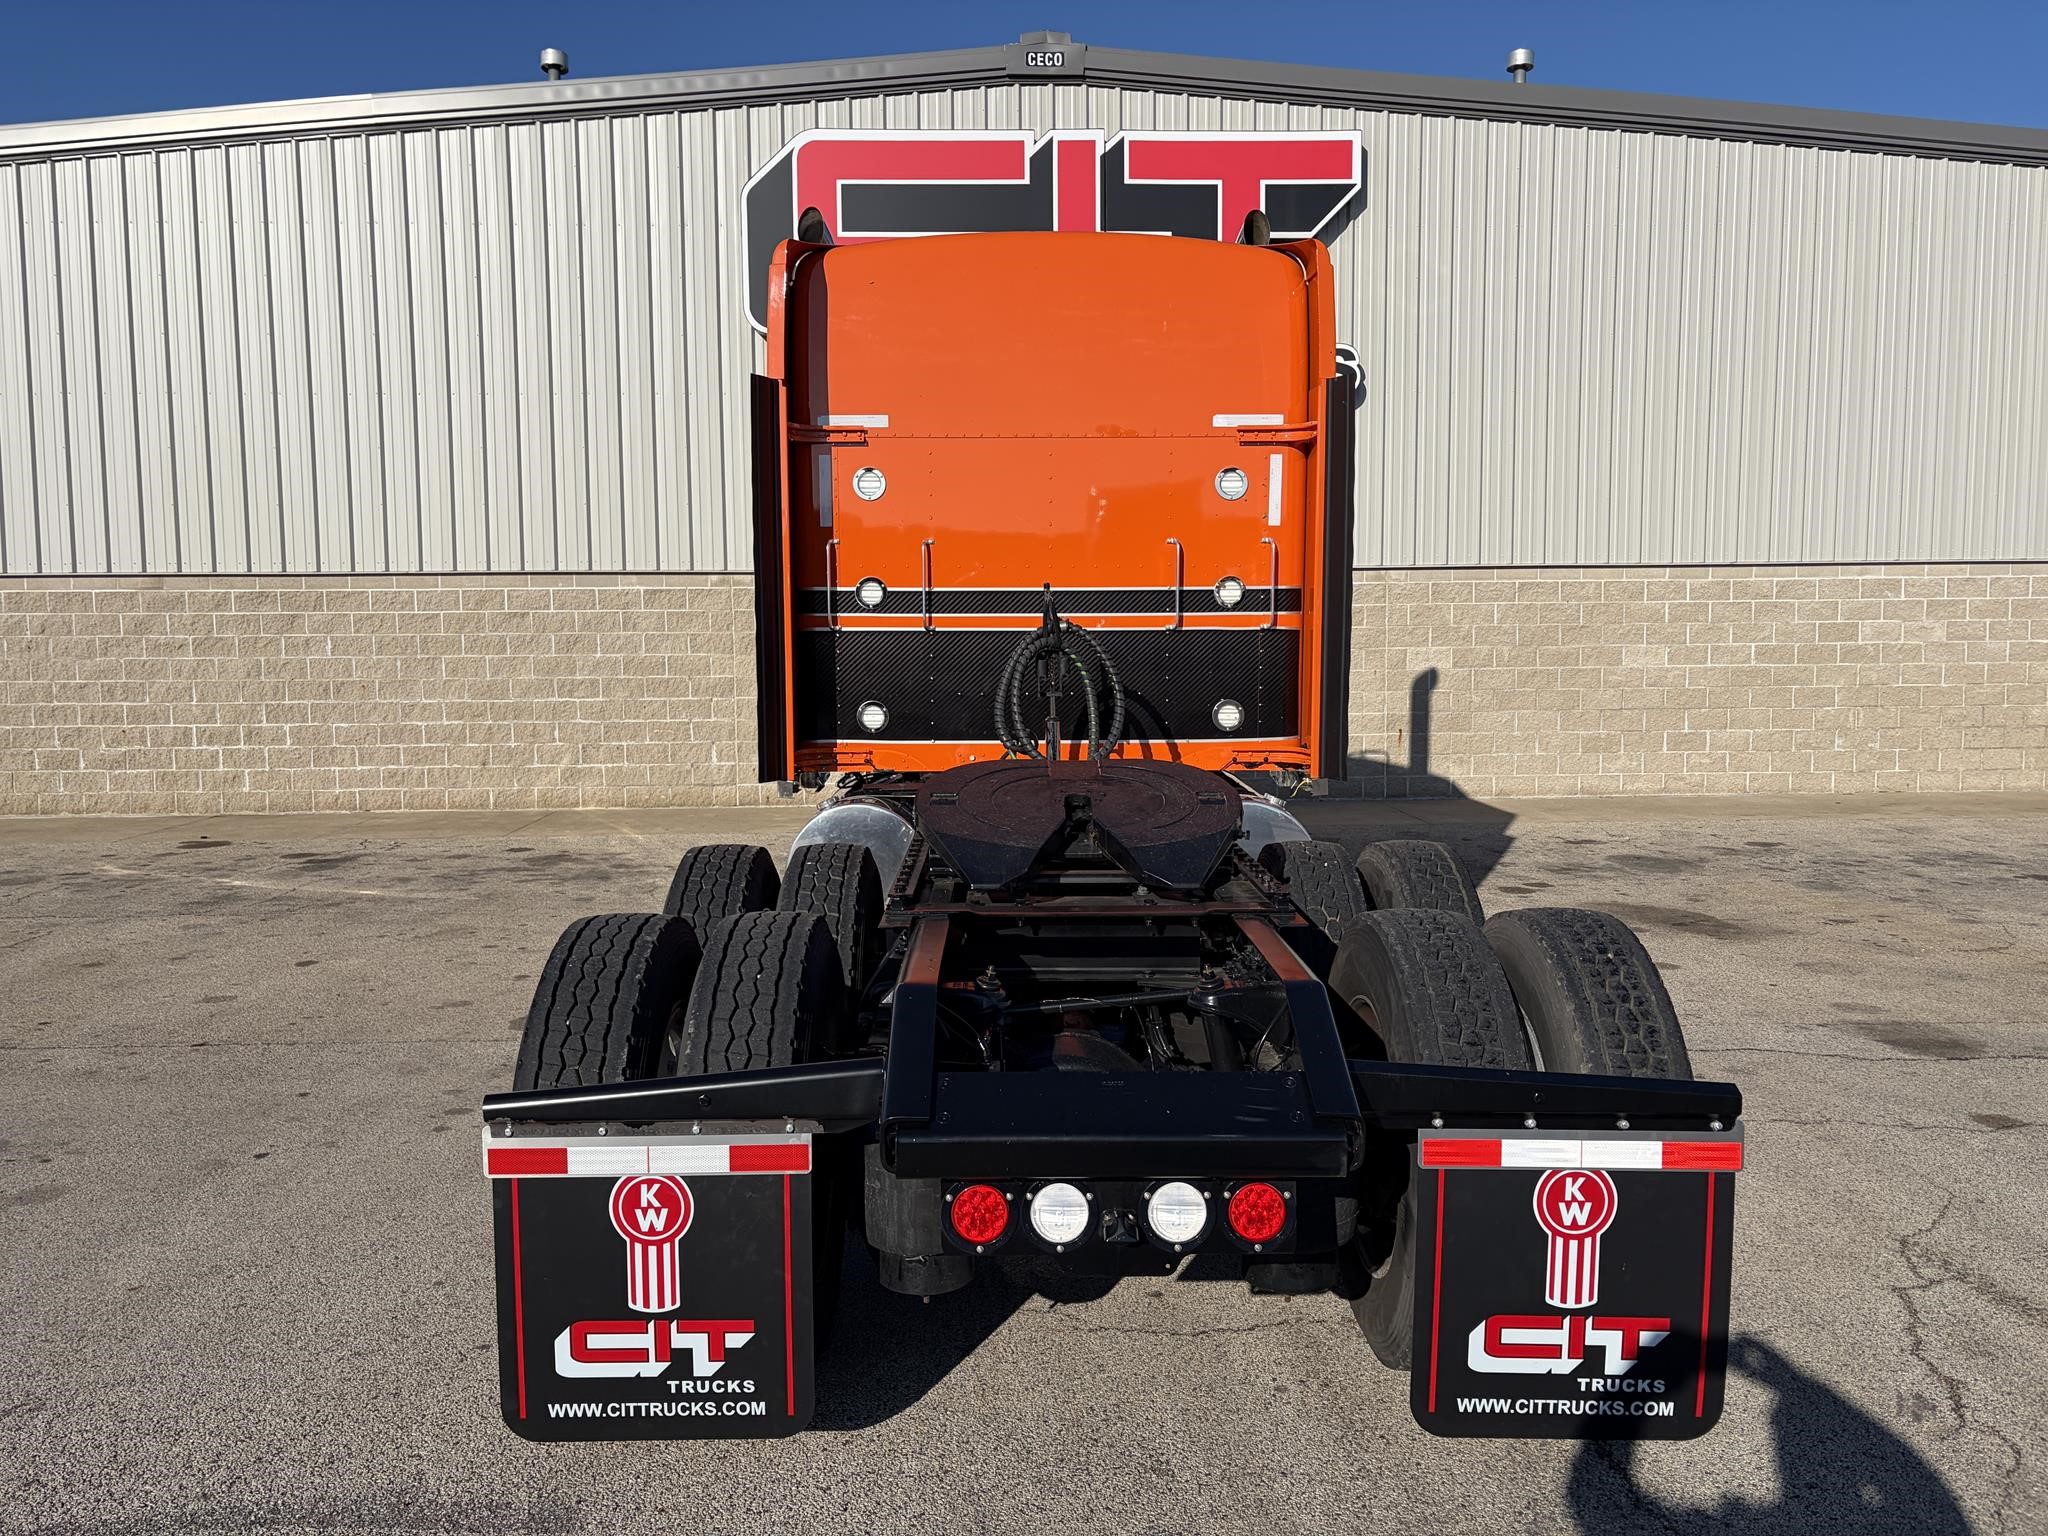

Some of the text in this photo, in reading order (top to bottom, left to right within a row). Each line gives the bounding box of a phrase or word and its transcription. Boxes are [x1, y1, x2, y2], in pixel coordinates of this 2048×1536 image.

[1027, 52, 1063, 66] CECO
[741, 129, 1362, 244] CIT
[554, 1320, 756, 1378] CIT
[1467, 1315, 1671, 1375] CIT
[667, 1380, 756, 1394] TRUCKS
[1577, 1378, 1666, 1393] TRUCKS
[548, 1401, 767, 1418] WWW.CITTRUCKS.COM
[1457, 1398, 1675, 1417] WWW.CITTRUCKS.COM
